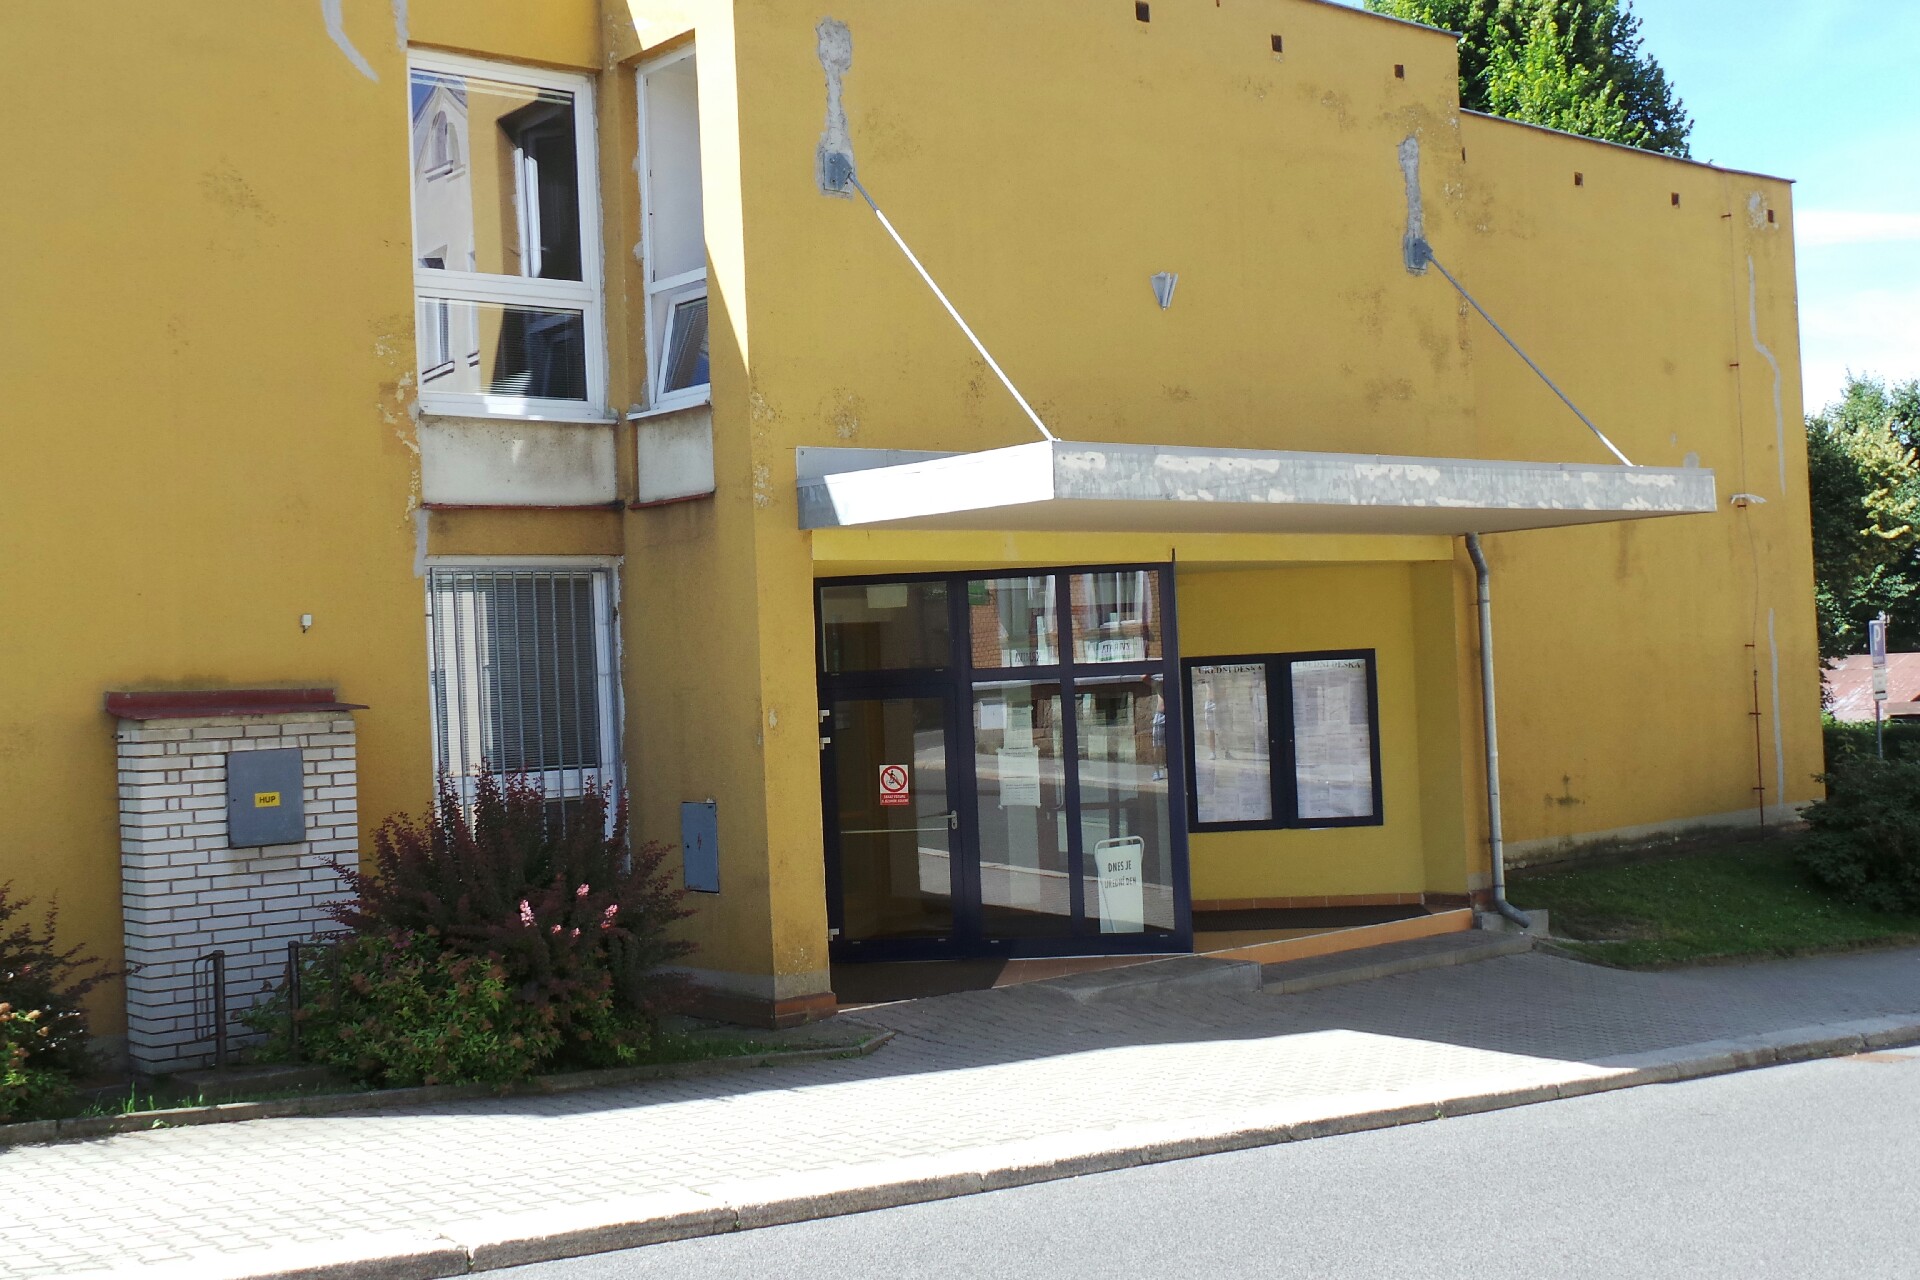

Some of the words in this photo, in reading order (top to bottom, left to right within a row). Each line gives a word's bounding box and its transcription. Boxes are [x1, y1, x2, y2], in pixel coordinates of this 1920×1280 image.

[1873, 624, 1881, 651] P
[259, 796, 276, 804] HUP
[1108, 860, 1124, 873] DNES
[1125, 859, 1132, 870] JE
[1126, 876, 1136, 886] DEN
